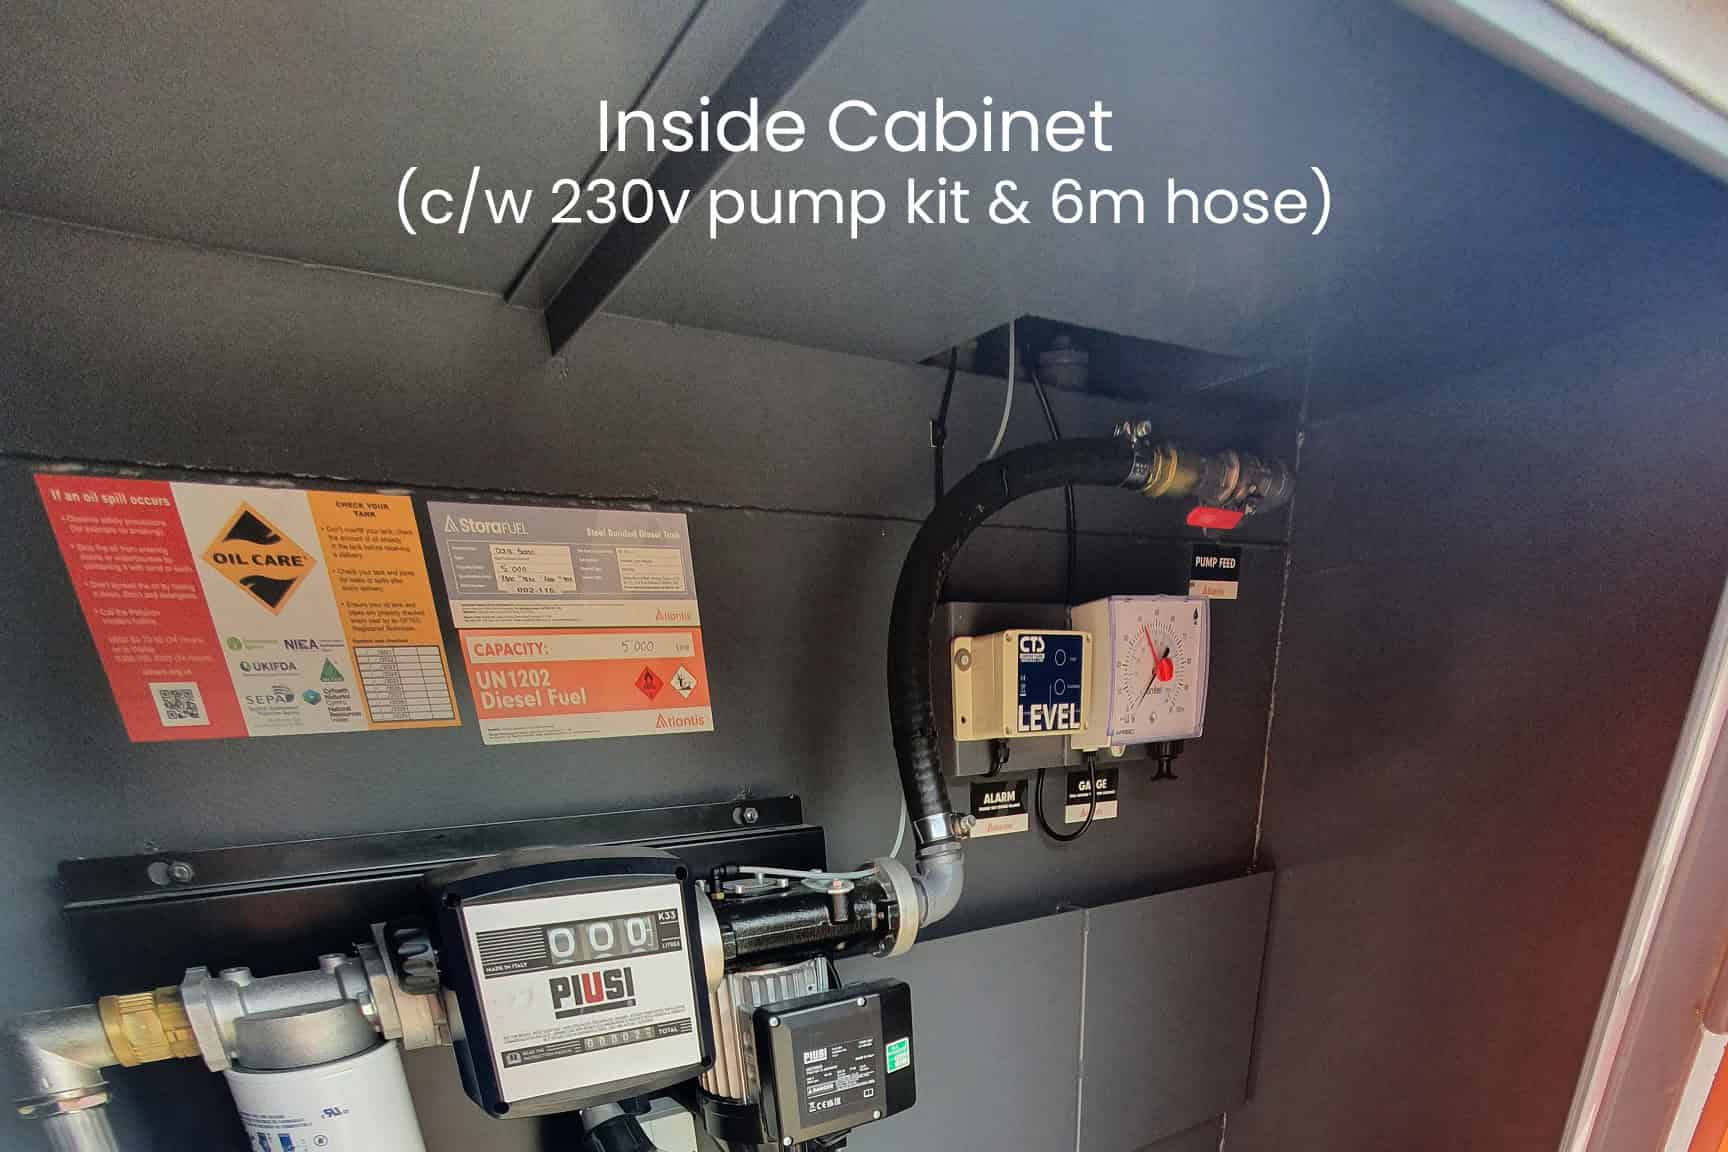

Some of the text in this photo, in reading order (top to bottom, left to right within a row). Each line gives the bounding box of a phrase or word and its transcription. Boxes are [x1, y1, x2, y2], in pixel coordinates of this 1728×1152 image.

[50, 488, 171, 507] If an oil spill occurs
[459, 516, 529, 536] StoraFUEL
[213, 552, 305, 567] OIL CARE
[1195, 555, 1236, 569] PUMP FEED
[473, 641, 551, 658] CAPACITY:
[481, 686, 588, 711] Diesel Fuel
[1018, 702, 1081, 732] LEVEL
[1078, 778, 1108, 791] GAGE
[983, 790, 1016, 805] ALARM
[657, 910, 677, 922] K33
[548, 965, 636, 1011] PIUSI
